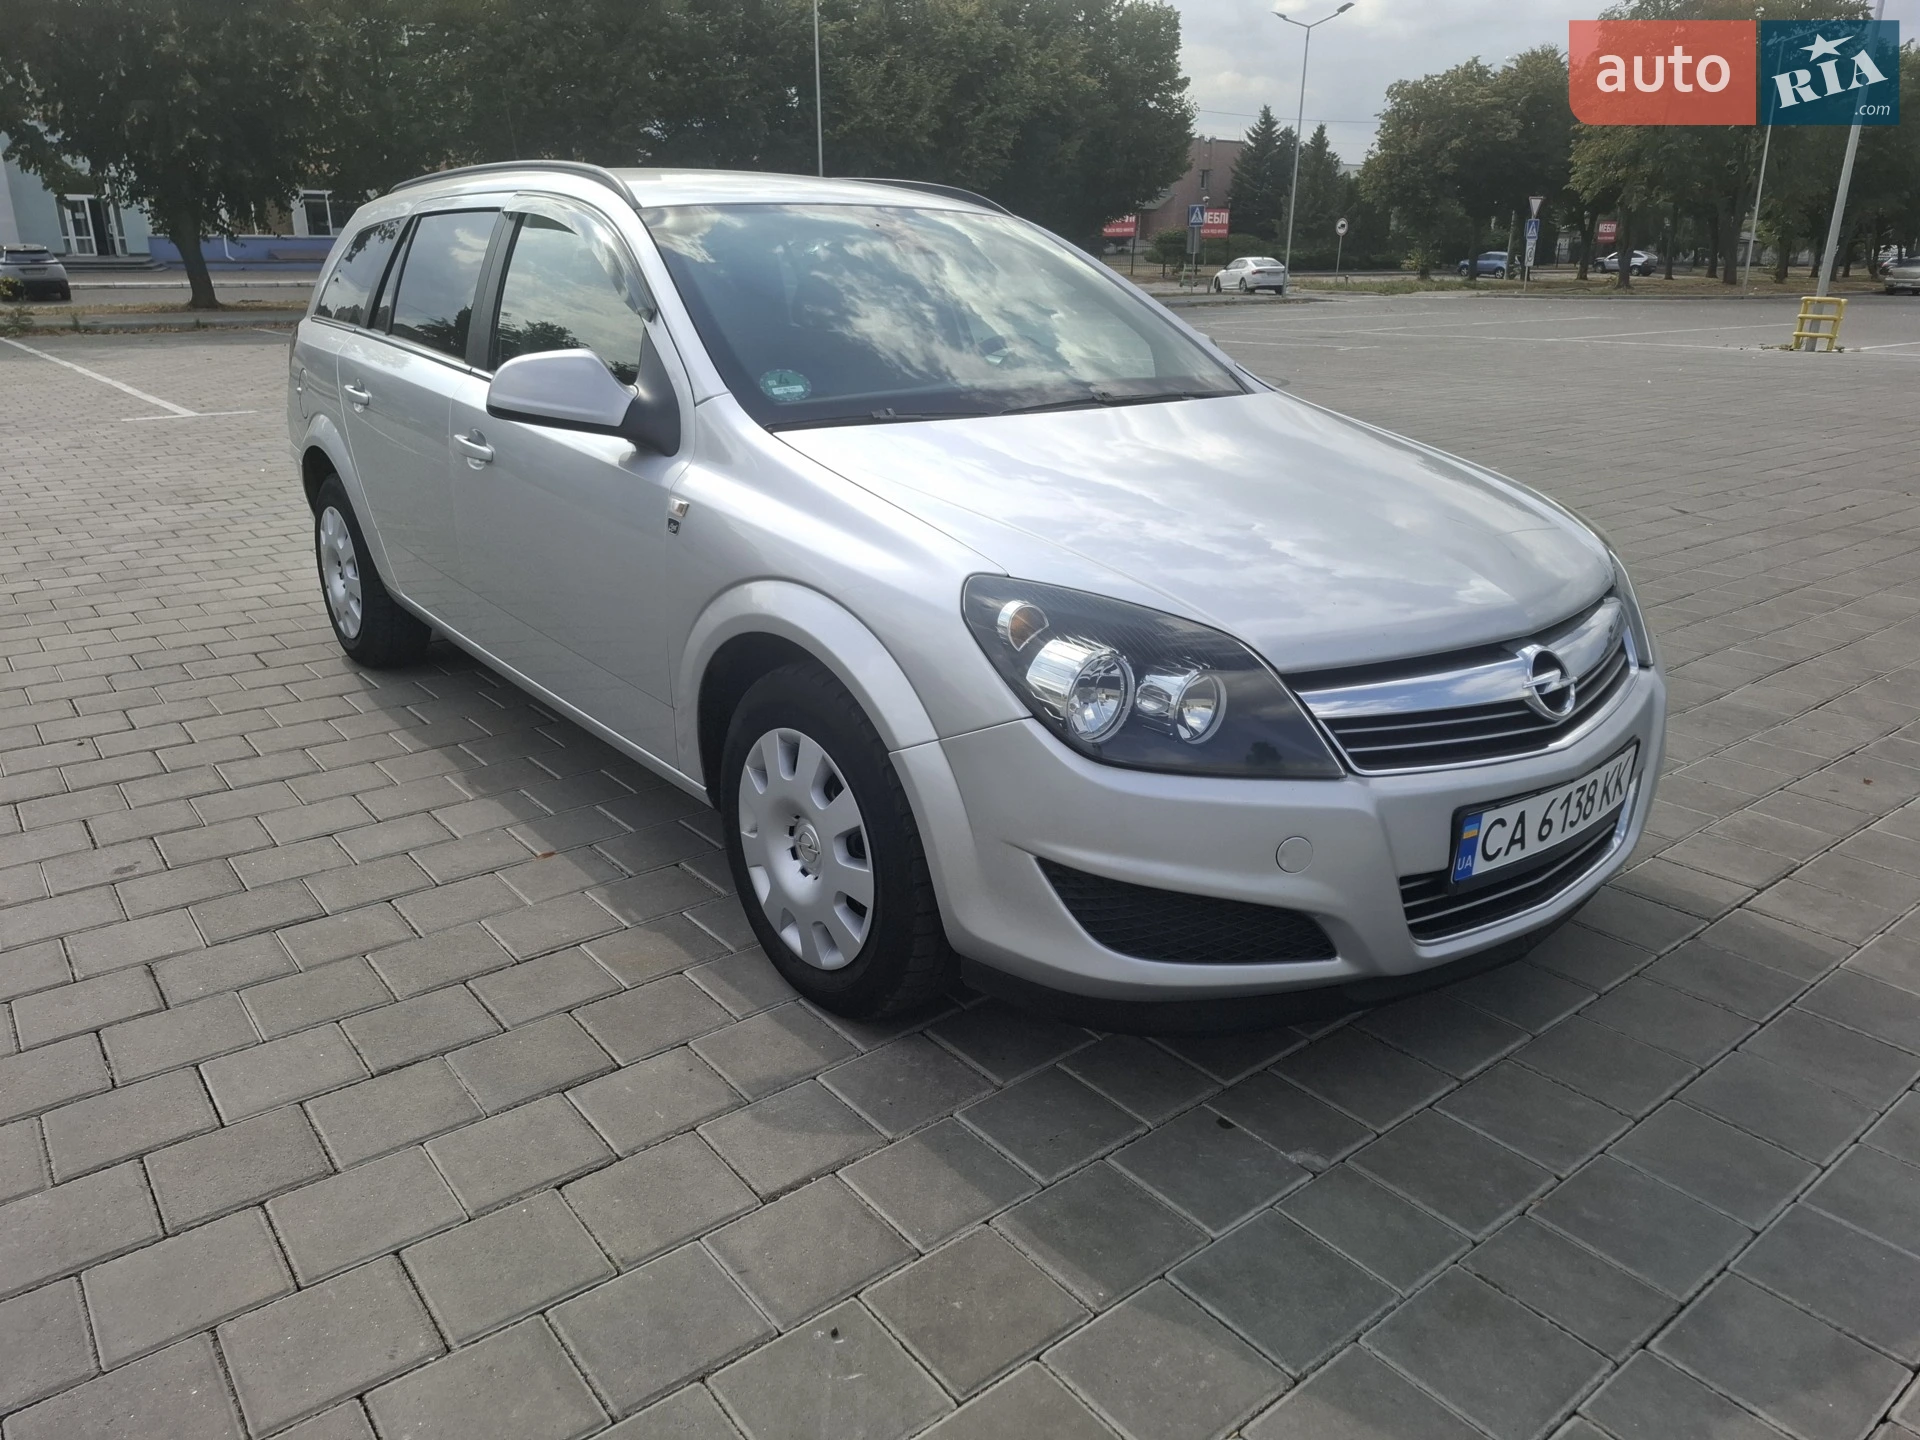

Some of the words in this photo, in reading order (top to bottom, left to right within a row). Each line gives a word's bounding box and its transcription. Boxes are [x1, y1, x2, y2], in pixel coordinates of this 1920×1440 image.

[1481, 810, 1526, 862] CA
[1537, 778, 1598, 842] 6138
[1598, 755, 1631, 812] KK
[1457, 855, 1472, 871] UA
